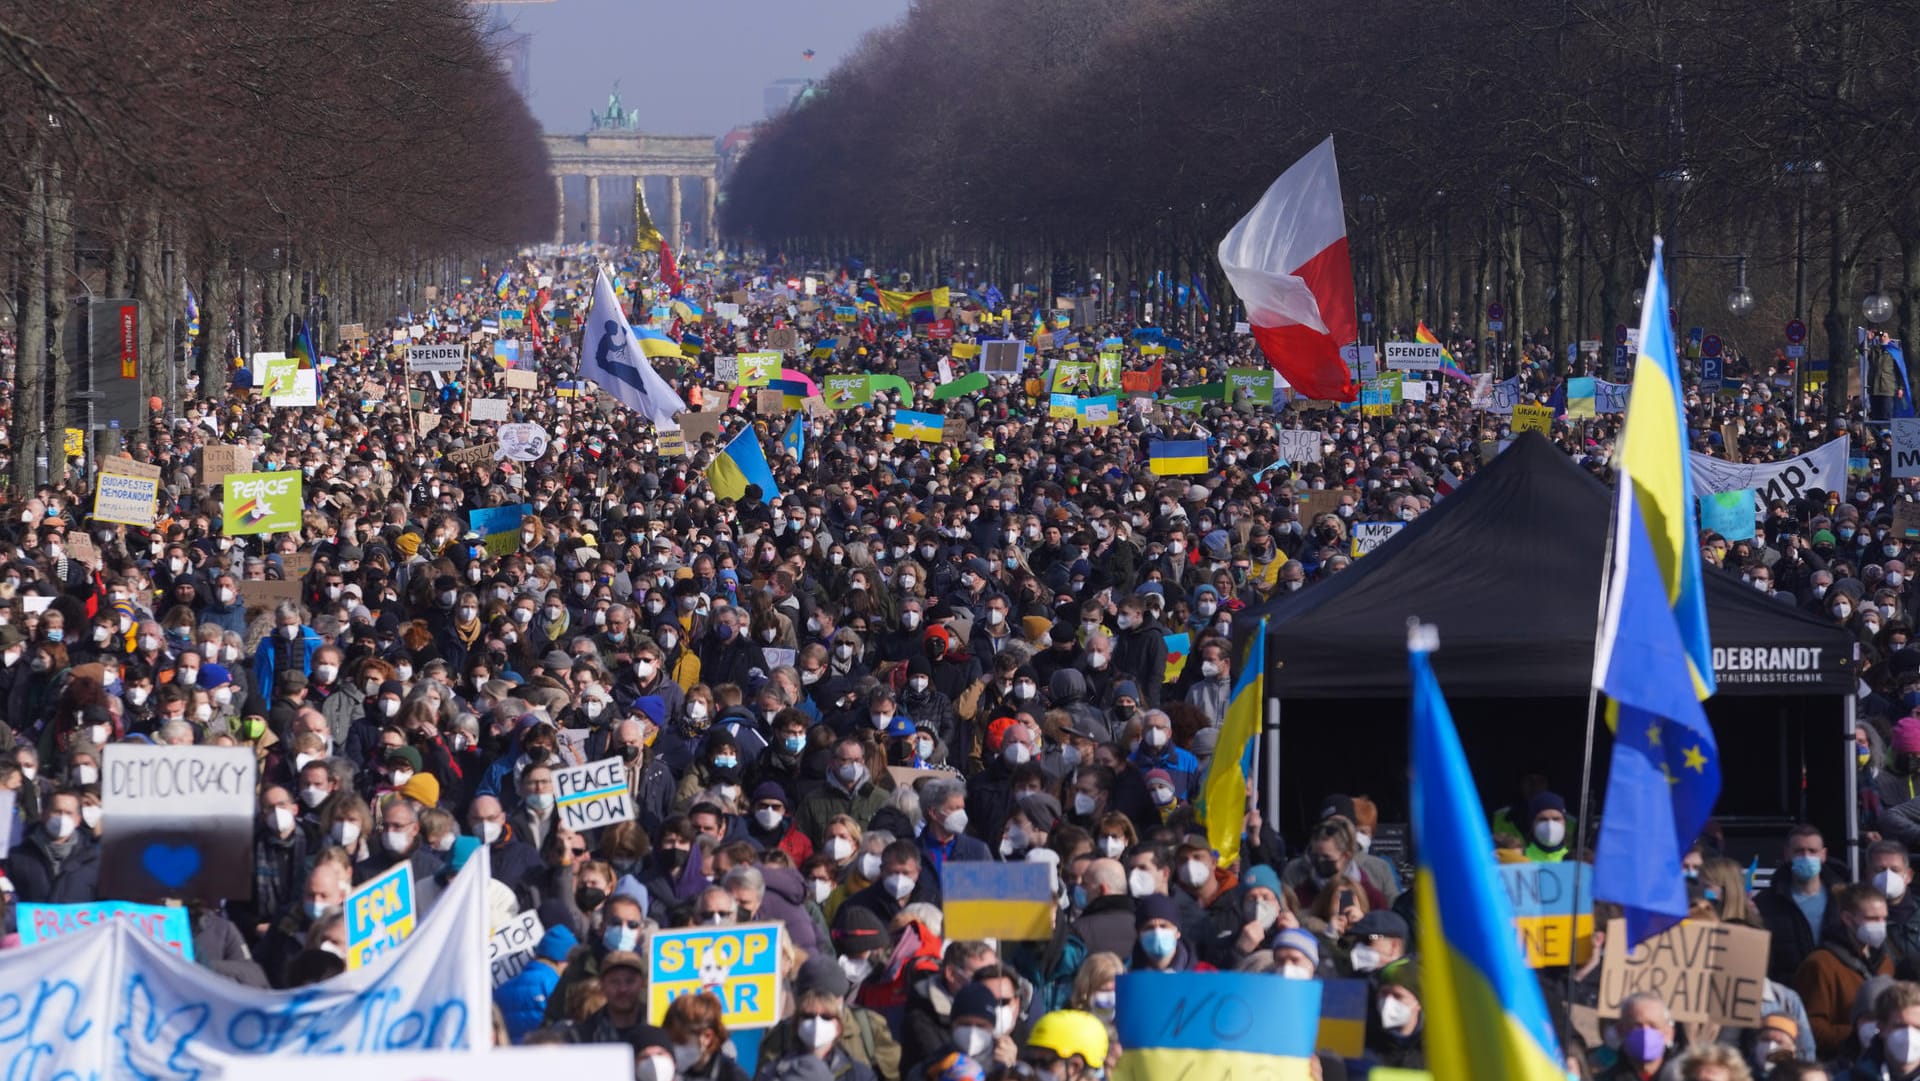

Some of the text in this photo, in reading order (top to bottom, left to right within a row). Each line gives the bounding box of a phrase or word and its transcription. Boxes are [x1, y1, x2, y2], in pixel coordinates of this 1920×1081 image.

[412, 349, 460, 359] SPENDEN
[1388, 347, 1439, 357] SPENDEN
[1704, 360, 1716, 377] P
[830, 378, 865, 389] PEACE
[1232, 374, 1270, 387] PEACE
[1281, 431, 1318, 447] STOP
[1283, 447, 1313, 462] WAR
[102, 476, 153, 490] BUDAPESTER
[231, 477, 294, 499] PEACE
[101, 487, 153, 502] MEMORANDUM
[1712, 647, 1822, 671] DEBRANDT
[111, 758, 247, 799] DEMOCRACY
[557, 763, 622, 796] PEACE
[566, 795, 625, 827] NOW
[356, 878, 402, 931] FCK
[659, 933, 769, 972] STOP
[1604, 967, 1757, 1022] UKRAINE
[1160, 991, 1254, 1041] NO
